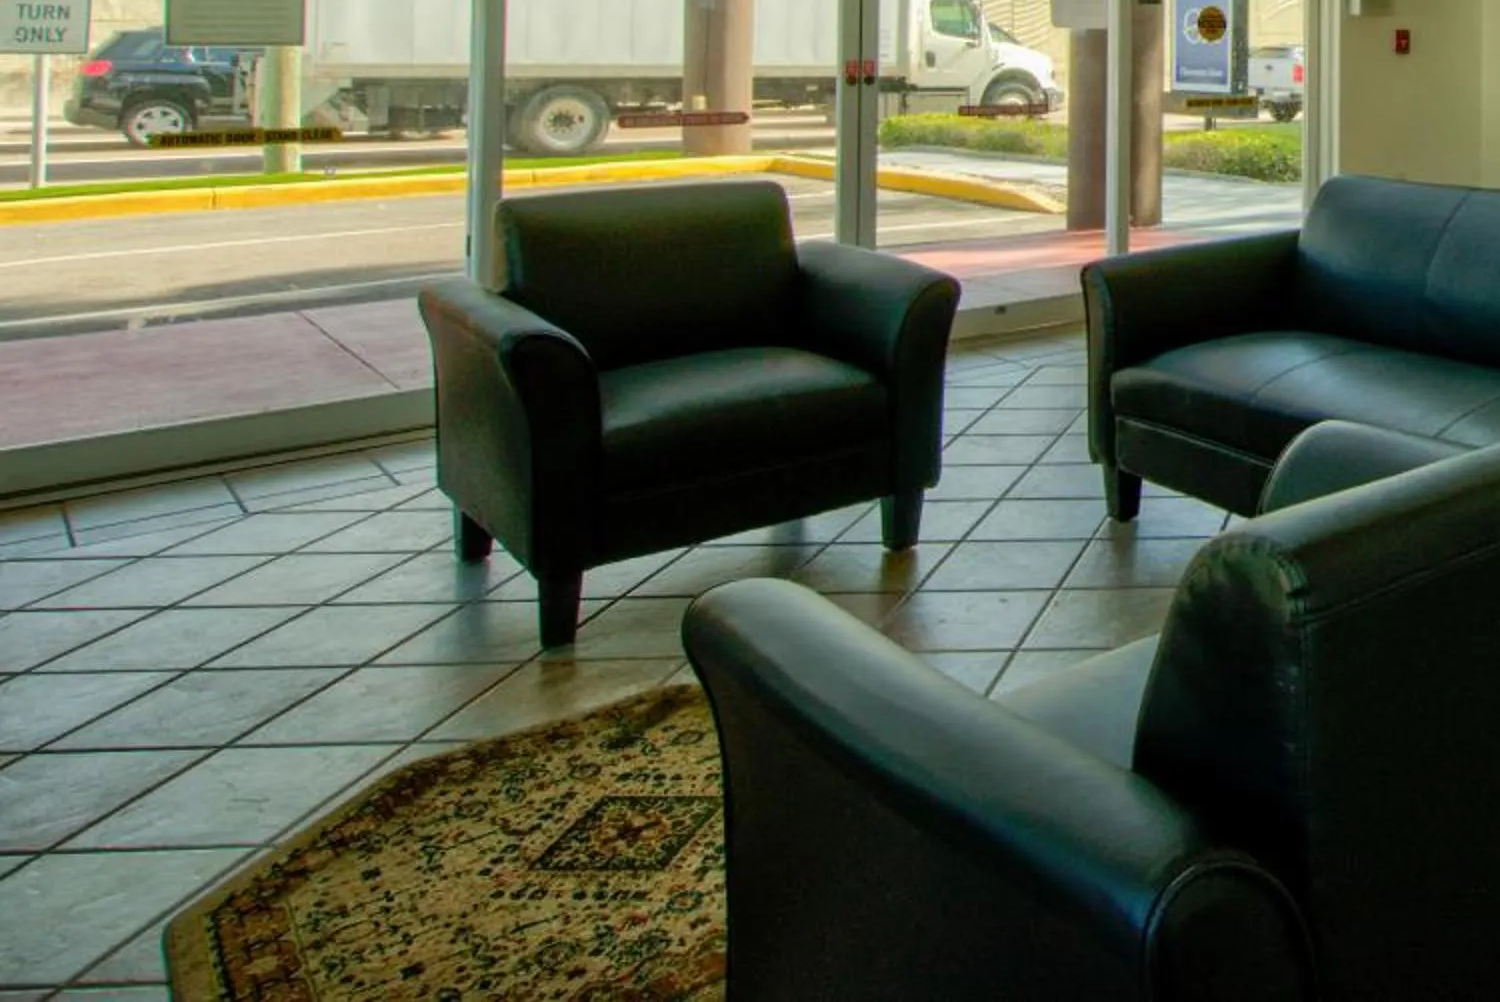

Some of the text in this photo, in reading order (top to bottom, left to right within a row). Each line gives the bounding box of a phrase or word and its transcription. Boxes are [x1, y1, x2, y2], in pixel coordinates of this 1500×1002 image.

[16, 2, 70, 20] TURN
[15, 26, 67, 43] ONLY
[160, 134, 222, 146] AUTOMATIC
